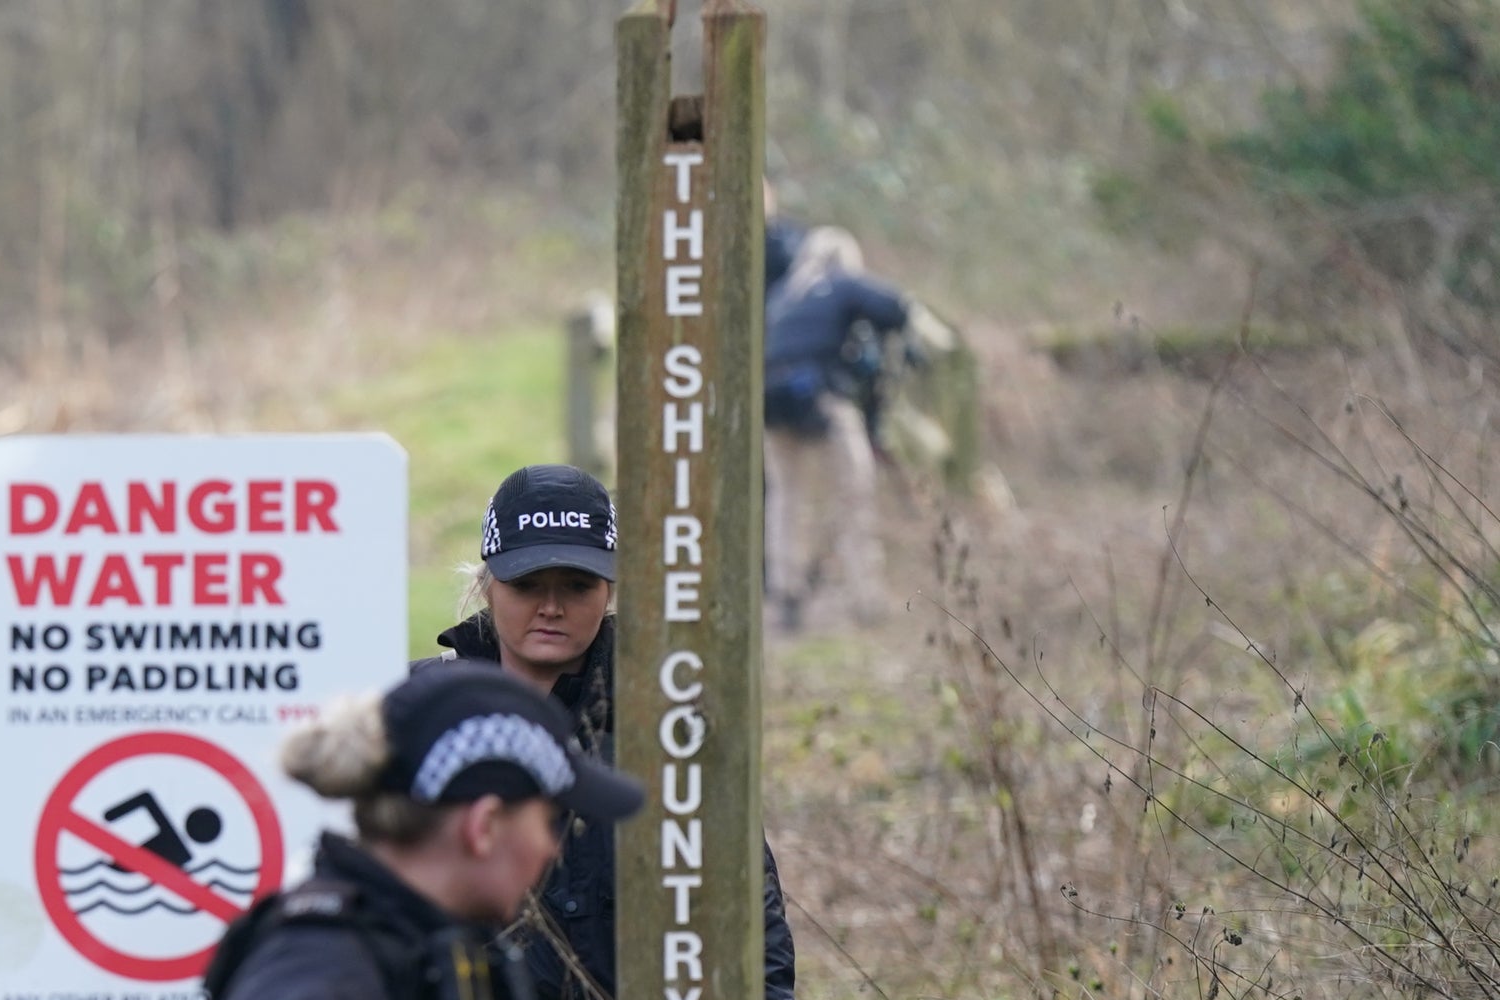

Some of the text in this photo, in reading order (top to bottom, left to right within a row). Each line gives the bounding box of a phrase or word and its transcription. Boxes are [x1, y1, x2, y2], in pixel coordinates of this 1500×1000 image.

[662, 152, 705, 317] THE
[662, 346, 704, 622] SHIRE
[7, 479, 341, 535] DANGER
[518, 511, 592, 531] POLICE
[5, 551, 286, 608] WATER
[10, 621, 323, 652] NO SWIMMING
[10, 662, 300, 693] NO PADDLING
[7, 706, 32, 725] IN
[37, 705, 68, 725] AN
[74, 705, 213, 724] EMERGENCY
[217, 704, 269, 723] CALL
